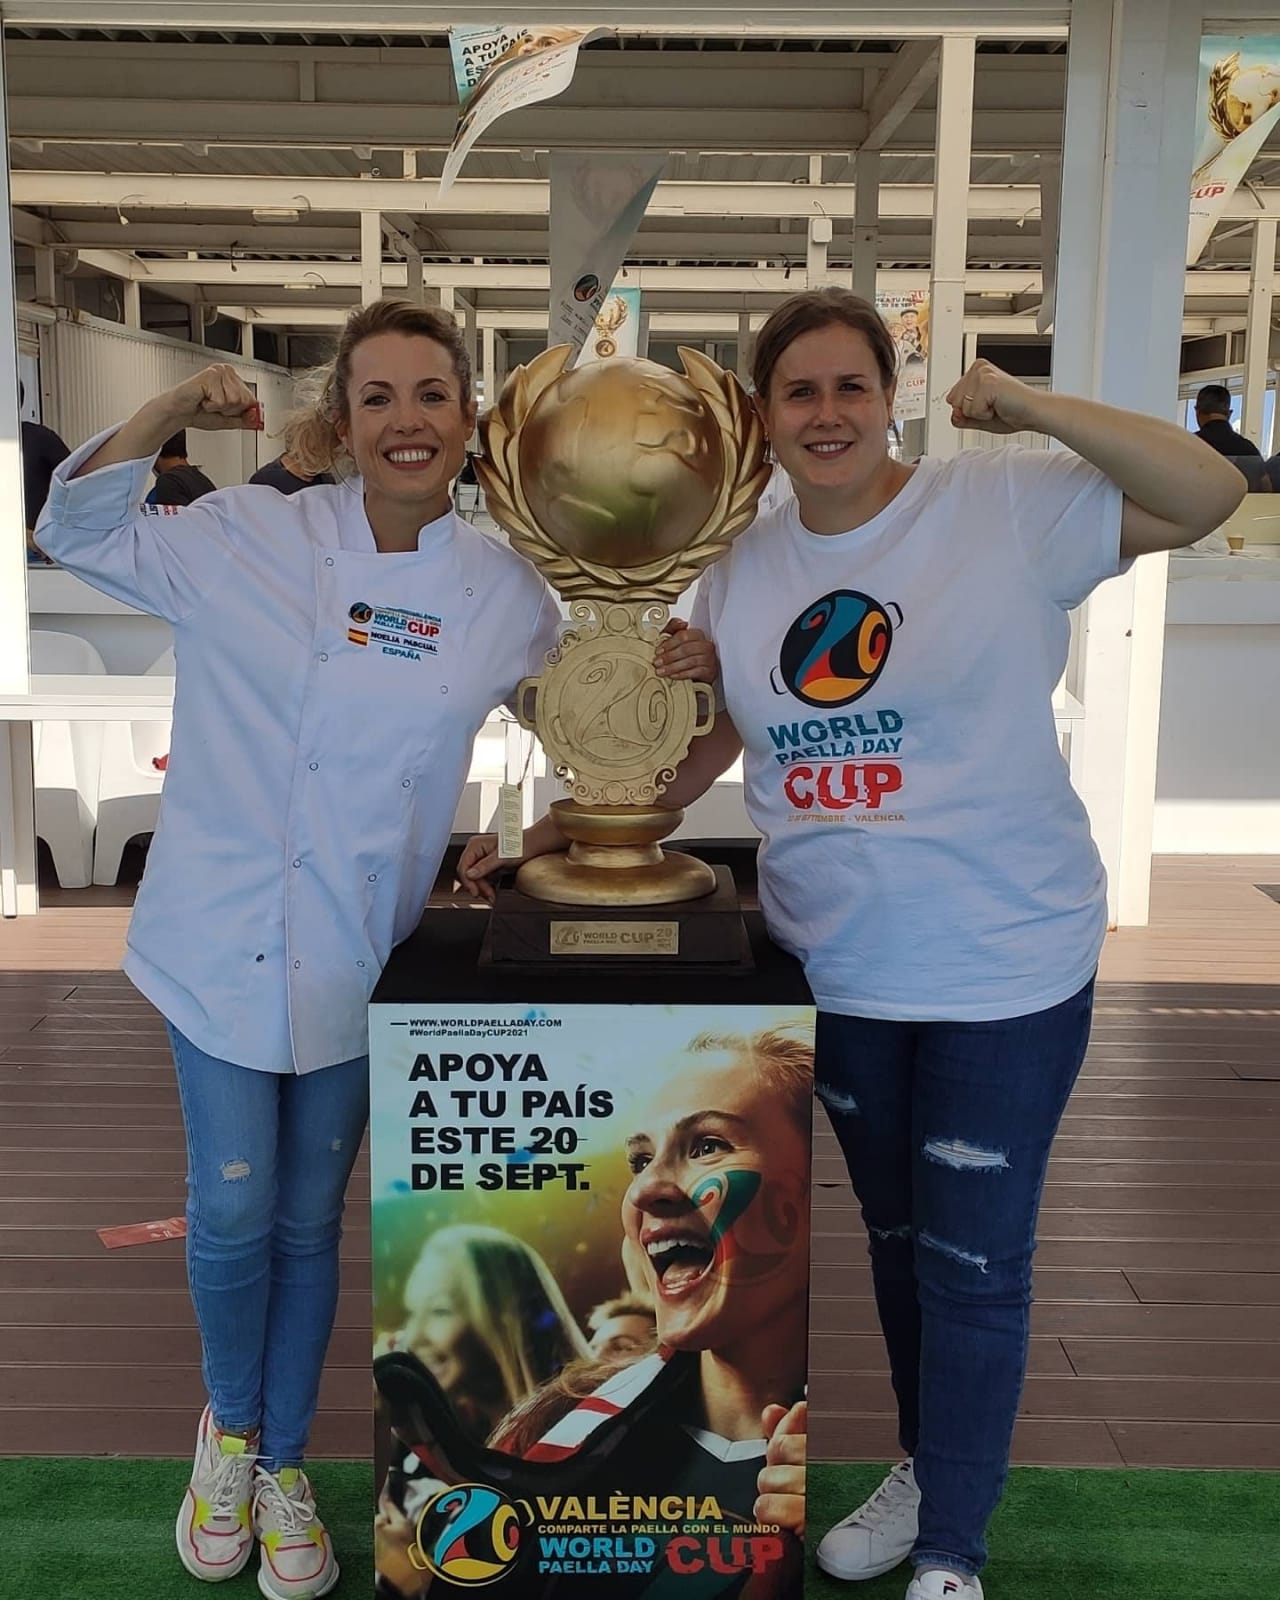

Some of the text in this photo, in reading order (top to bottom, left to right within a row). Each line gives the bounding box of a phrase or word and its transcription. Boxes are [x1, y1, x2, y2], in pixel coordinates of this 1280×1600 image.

[462, 34, 508, 56] APOYA
[464, 58, 474, 67] A
[478, 50, 497, 62] TU
[374, 612, 407, 626] WORLD
[407, 621, 440, 638] CUP
[371, 631, 438, 652] NOELIA PASCUAL
[382, 646, 421, 661] ESPAÑA
[768, 709, 903, 749] WORLD
[775, 737, 903, 766] PAELLA DAY
[784, 763, 903, 810] CUP
[620, 932, 654, 944] CUP
[656, 928, 673, 938] 20
[409, 1019, 562, 1028] WWW.WORLDPAELLADAY.COM
[409, 1029, 529, 1038] #WorldPaellaDayCUP2021
[408, 1053, 548, 1082] APOYA
[408, 1083, 614, 1118] A TU PAÍS
[411, 1126, 579, 1154] ESTE 20
[411, 1163, 590, 1190] DE SEPT.
[536, 1490, 724, 1520] VALÈNCIA
[537, 1524, 780, 1534] COMPARTE LA PAELLA CON EL MUNDO
[538, 1536, 784, 1575] WORLD CUP
[538, 1560, 654, 1573] PAELLA DAY
